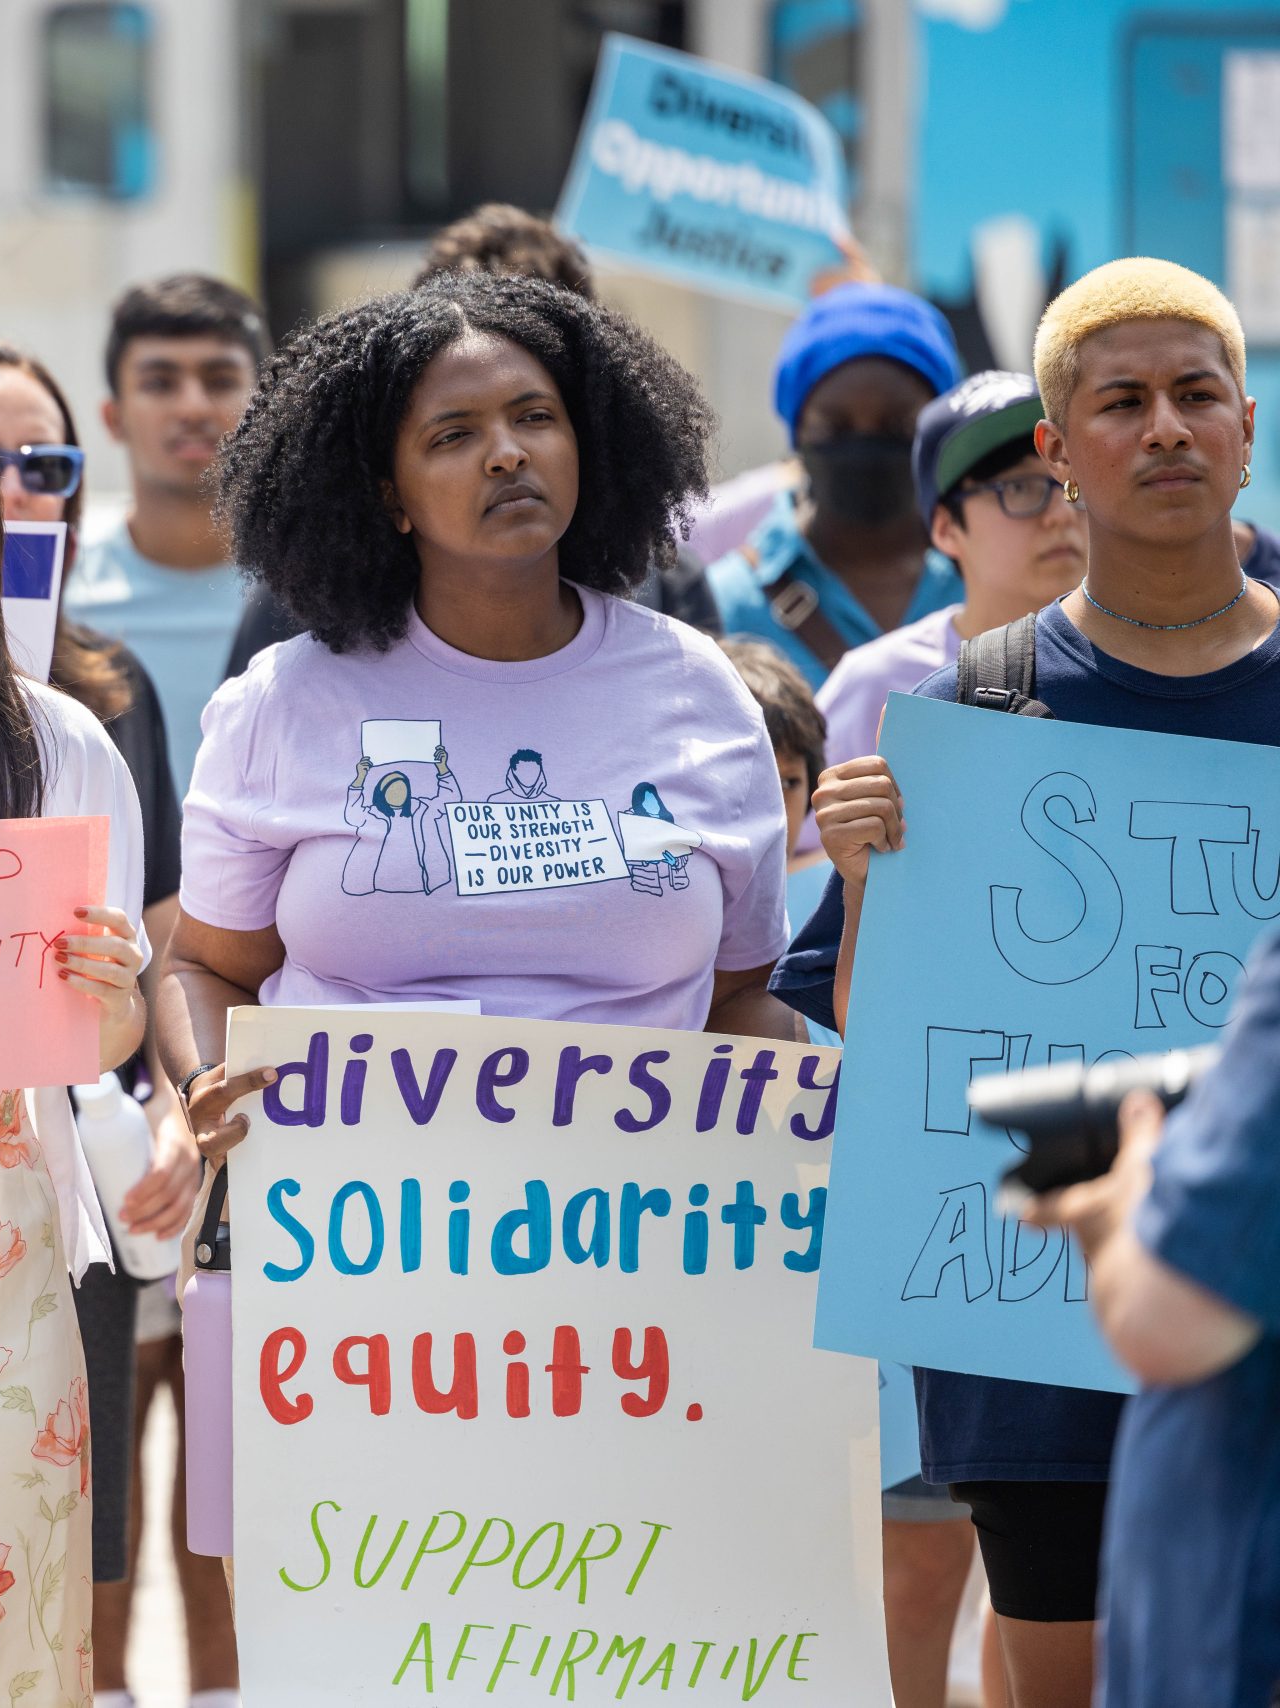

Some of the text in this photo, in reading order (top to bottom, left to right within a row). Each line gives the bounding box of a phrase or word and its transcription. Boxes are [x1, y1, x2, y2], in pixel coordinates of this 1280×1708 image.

[454, 803, 591, 822] OUR UNITY IS
[467, 819, 594, 840] OUR STRENGTH
[467, 857, 605, 887] IS OUR POWER
[263, 1031, 841, 1141] diversity
[263, 1178, 827, 1283] solidarity
[259, 1325, 703, 1425] equity.
[278, 1500, 672, 1604] SUPPORT
[391, 1622, 819, 1701] AFFIRMATIVE
